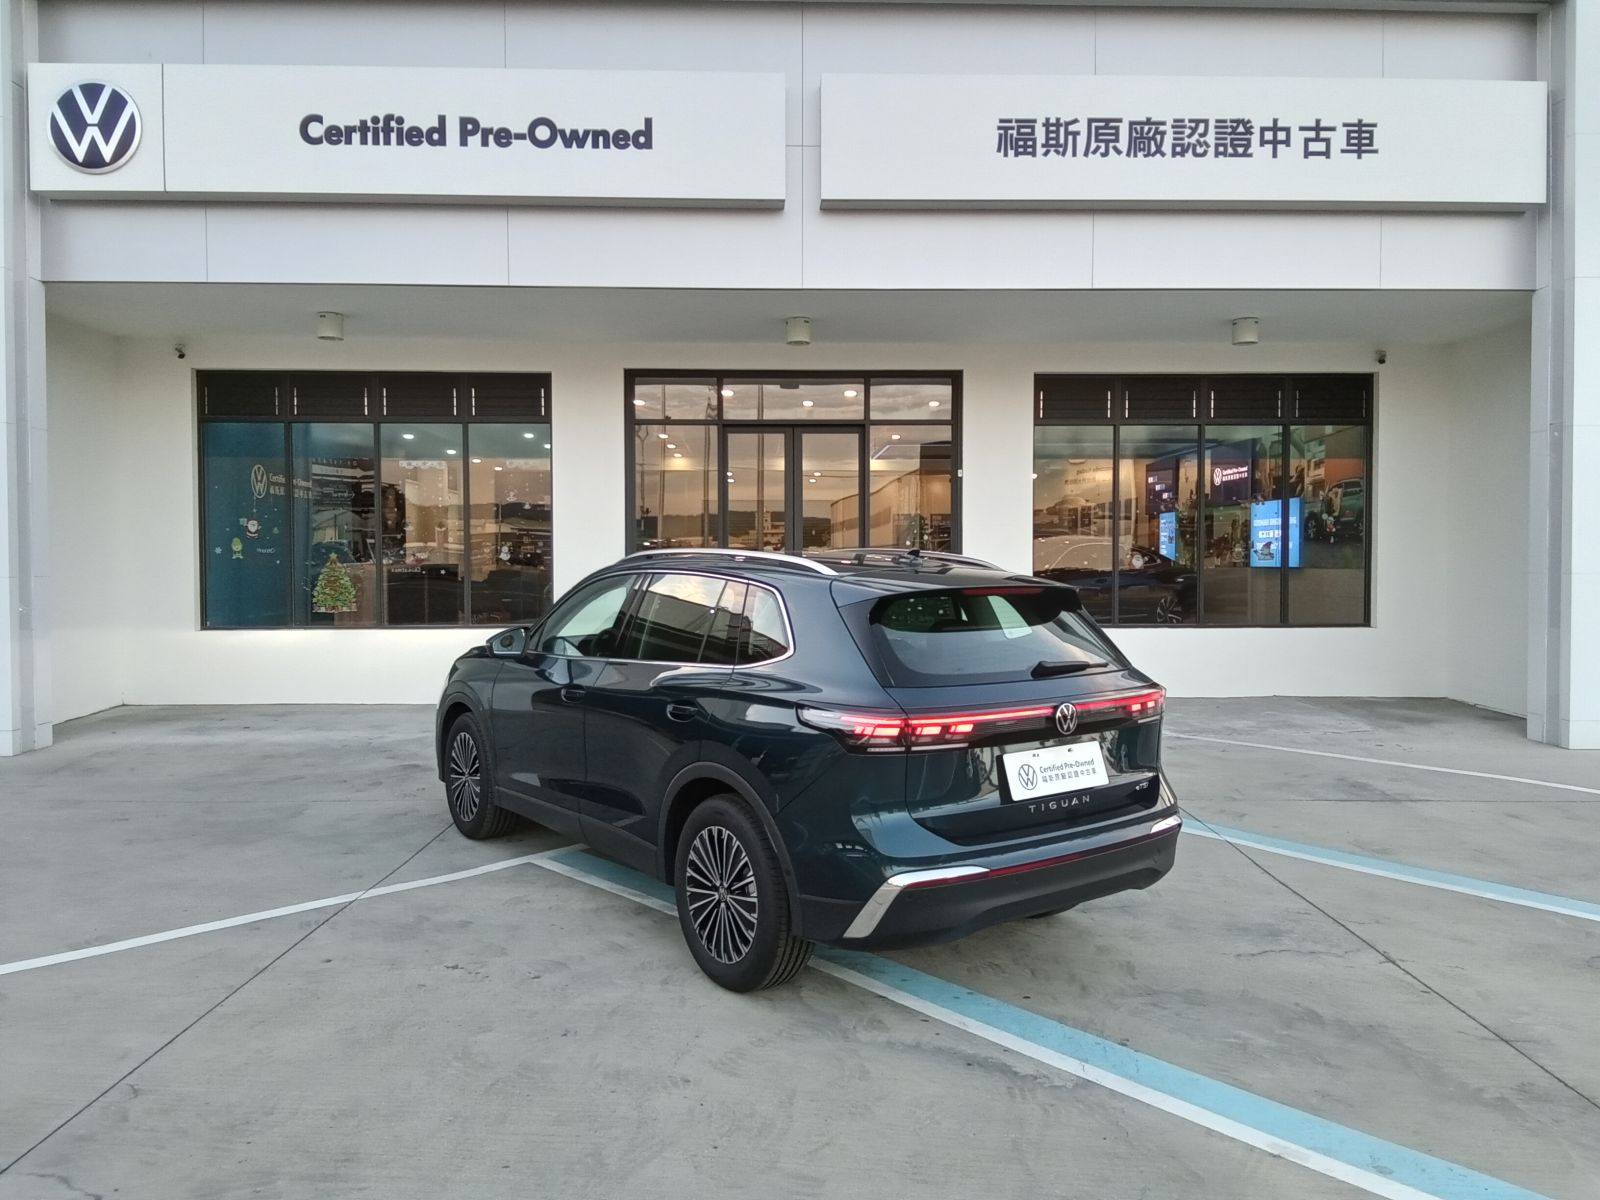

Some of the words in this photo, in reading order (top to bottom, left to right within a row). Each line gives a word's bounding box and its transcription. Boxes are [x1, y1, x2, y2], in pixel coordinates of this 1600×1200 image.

[300, 113, 447, 147] Certified
[459, 117, 653, 149] Pre-Owned
[996, 117, 1379, 160] 福斯原廠認證中古車
[1040, 763, 1064, 774] Certified
[1064, 757, 1095, 770] Pre-Owned
[1028, 795, 1090, 813] TIGUAN
